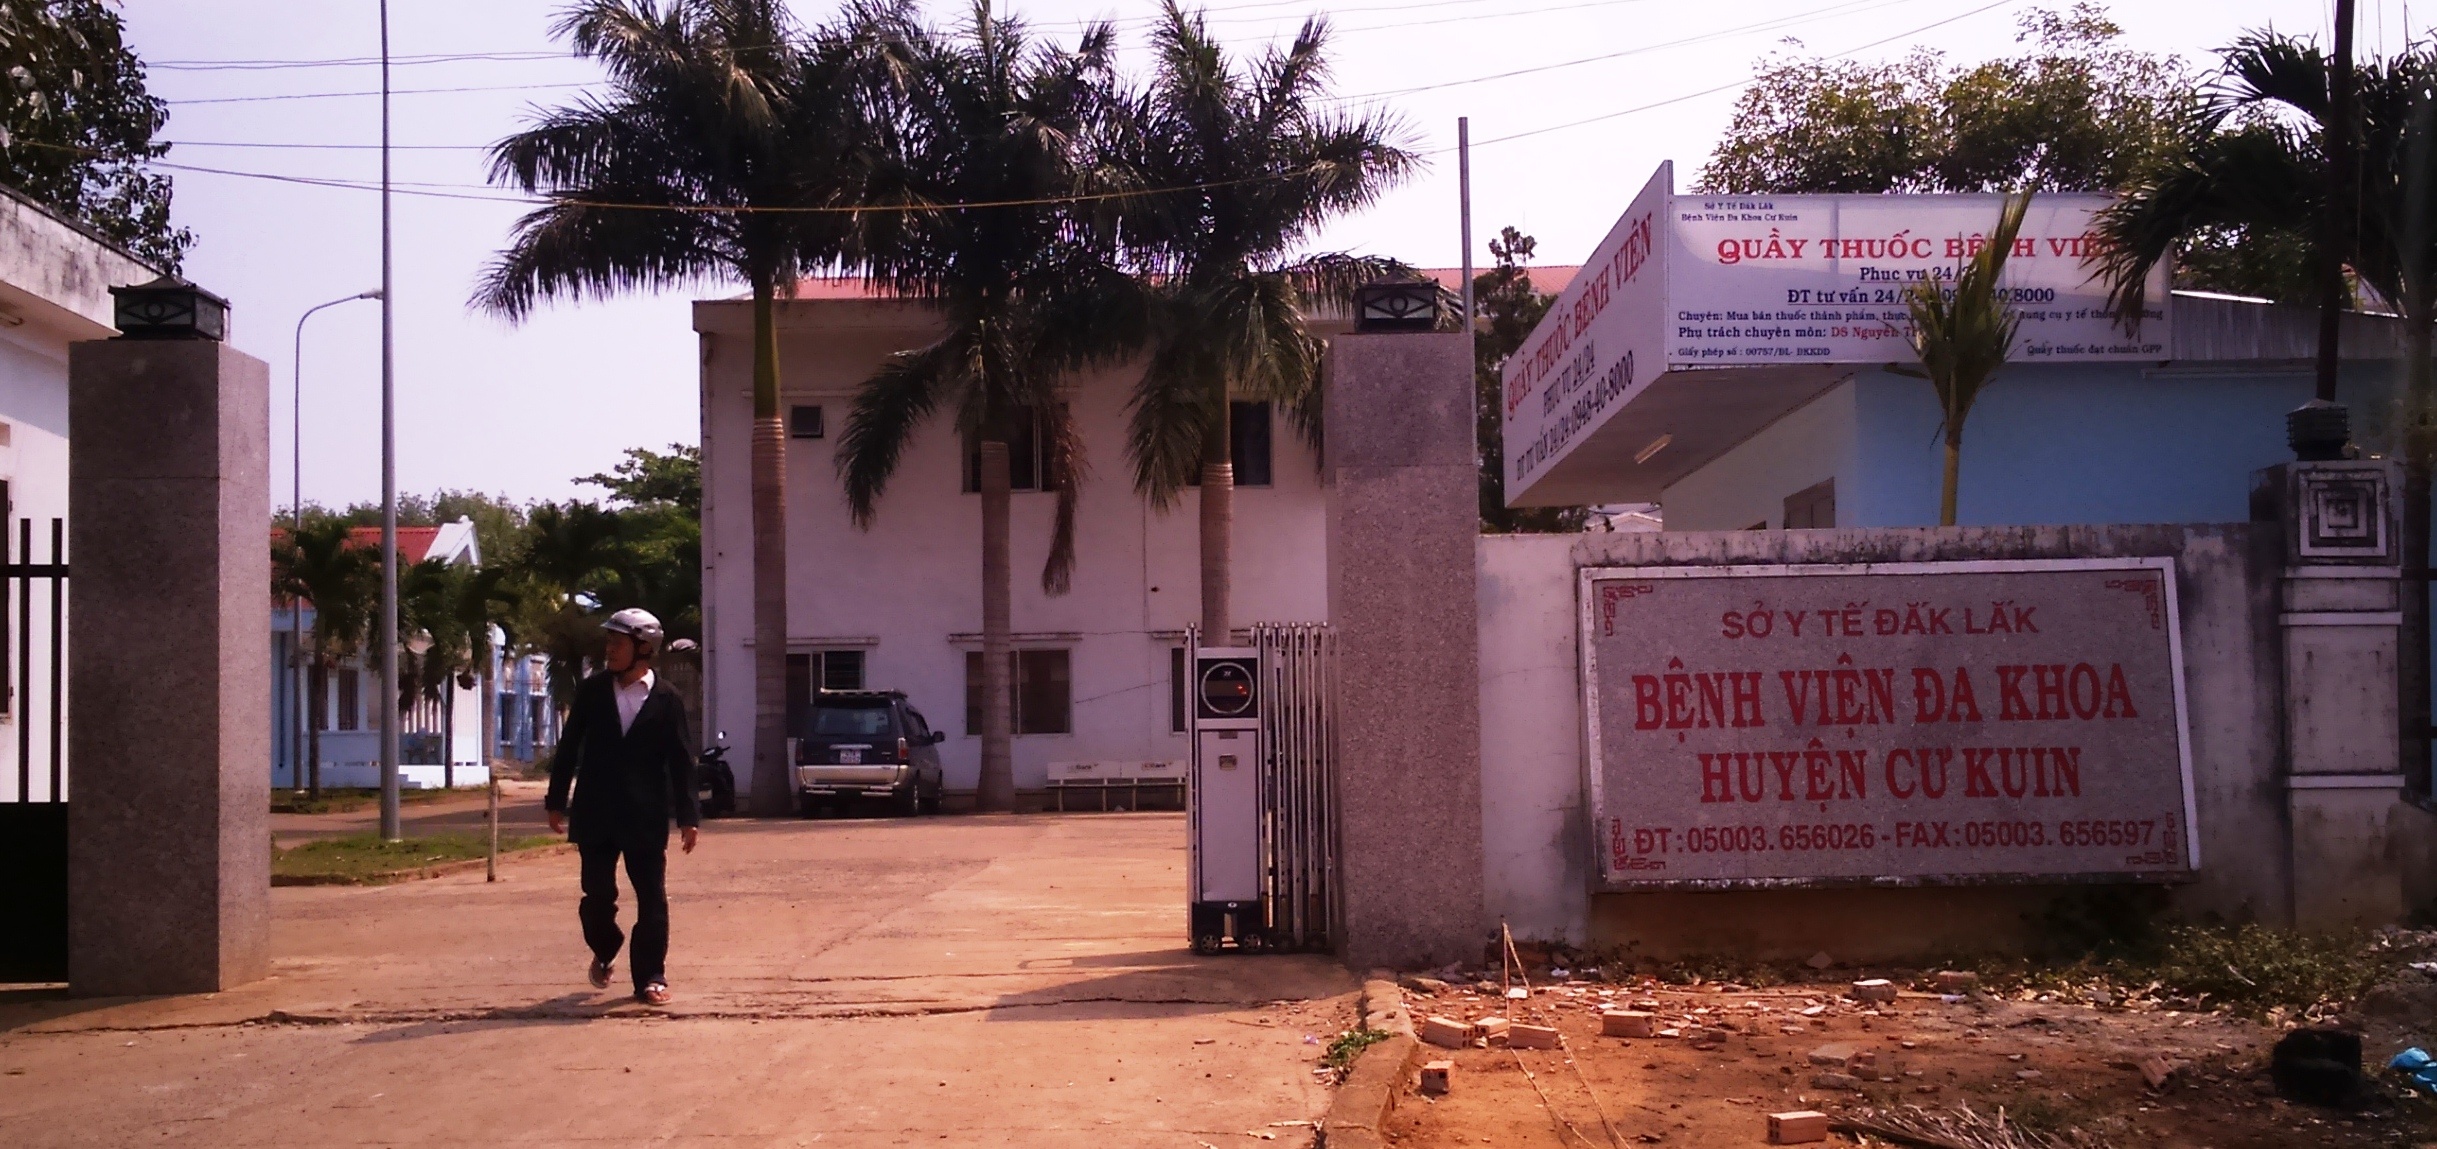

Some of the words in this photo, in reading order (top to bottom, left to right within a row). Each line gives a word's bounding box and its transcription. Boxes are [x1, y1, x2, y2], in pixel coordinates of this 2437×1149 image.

[1717, 227, 1808, 265] QUẦY
[1819, 229, 1933, 259] THUỐC
[1574, 264, 1610, 340] BỆNH
[1614, 213, 1653, 290] VIỆN
[1787, 289, 1811, 303] ĐT
[1726, 311, 1749, 321] Mua
[1831, 327, 1849, 338] DS
[1721, 600, 1774, 640] SỞ
[1783, 609, 1807, 638] Y
[1818, 600, 1868, 637] TẾ
[1873, 601, 1953, 636] ĐẮK
[1964, 600, 2039, 635] LẮK
[1632, 655, 1765, 744] BỆNH
[1779, 652, 1895, 740] VIỆN
[1911, 665, 1983, 724] ĐA
[1996, 661, 2139, 722] KHOA
[1697, 736, 1868, 814] HUYỆN
[1885, 746, 1953, 800] CƯ
[1961, 746, 2082, 799] KUIN
